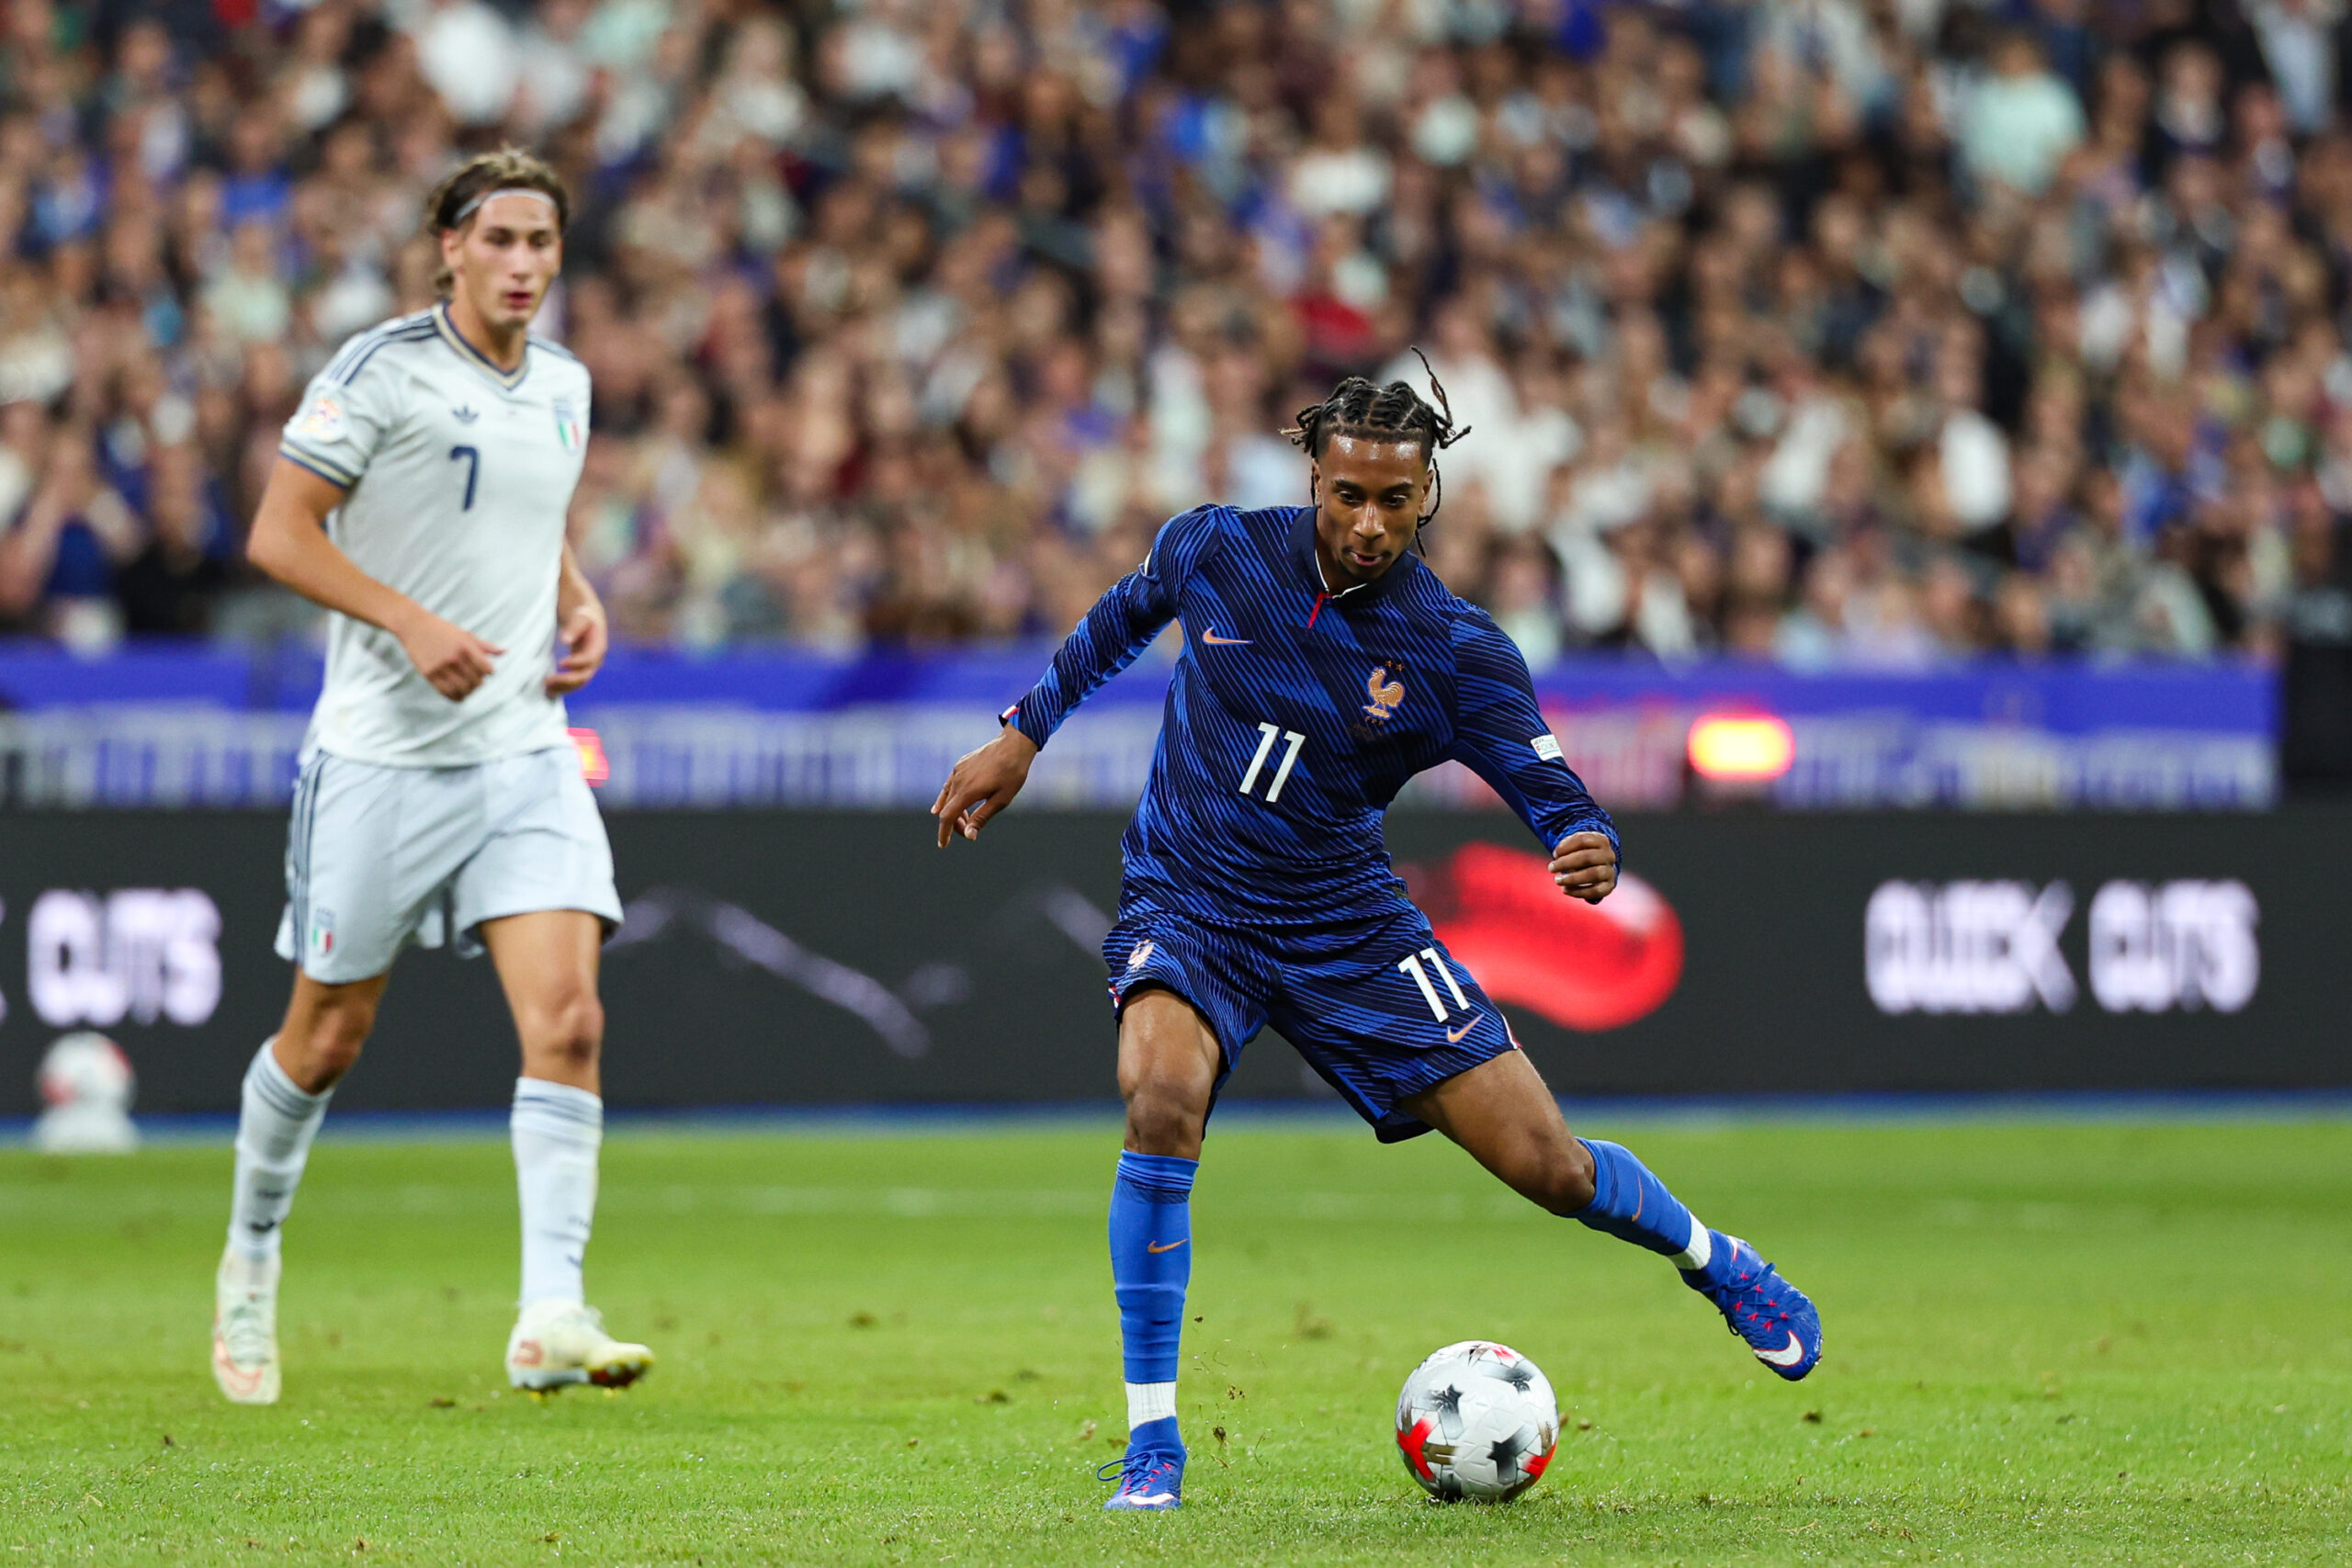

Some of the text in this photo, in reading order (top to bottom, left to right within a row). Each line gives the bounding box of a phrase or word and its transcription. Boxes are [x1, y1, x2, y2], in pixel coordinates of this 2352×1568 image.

[449, 446, 480, 512] 7
[1238, 721, 1306, 803] 11
[1397, 947, 1470, 1023] 11
